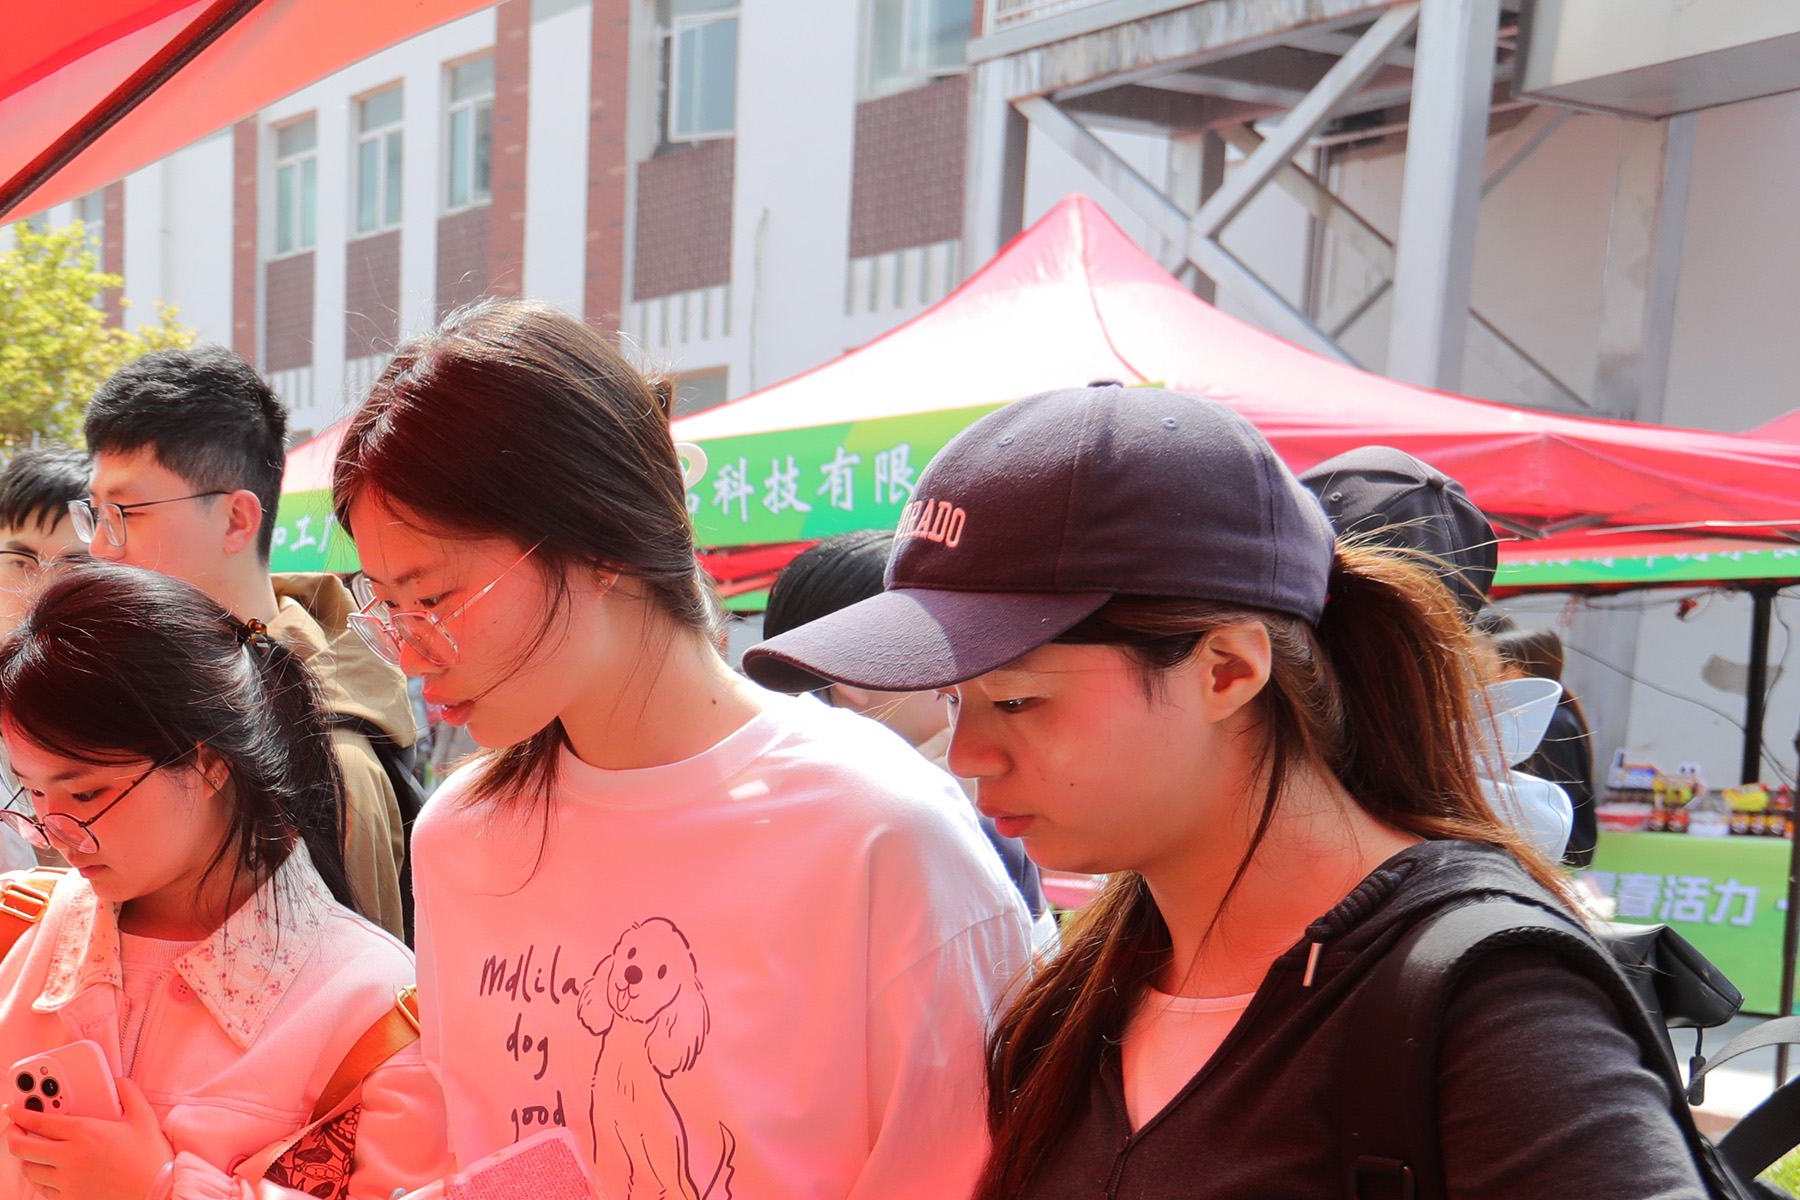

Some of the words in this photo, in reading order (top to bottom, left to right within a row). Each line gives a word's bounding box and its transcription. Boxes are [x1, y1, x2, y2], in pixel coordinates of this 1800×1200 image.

[686, 443, 916, 523] 科技有限
[506, 1012, 549, 1081] dog
[511, 1089, 567, 1143] good
